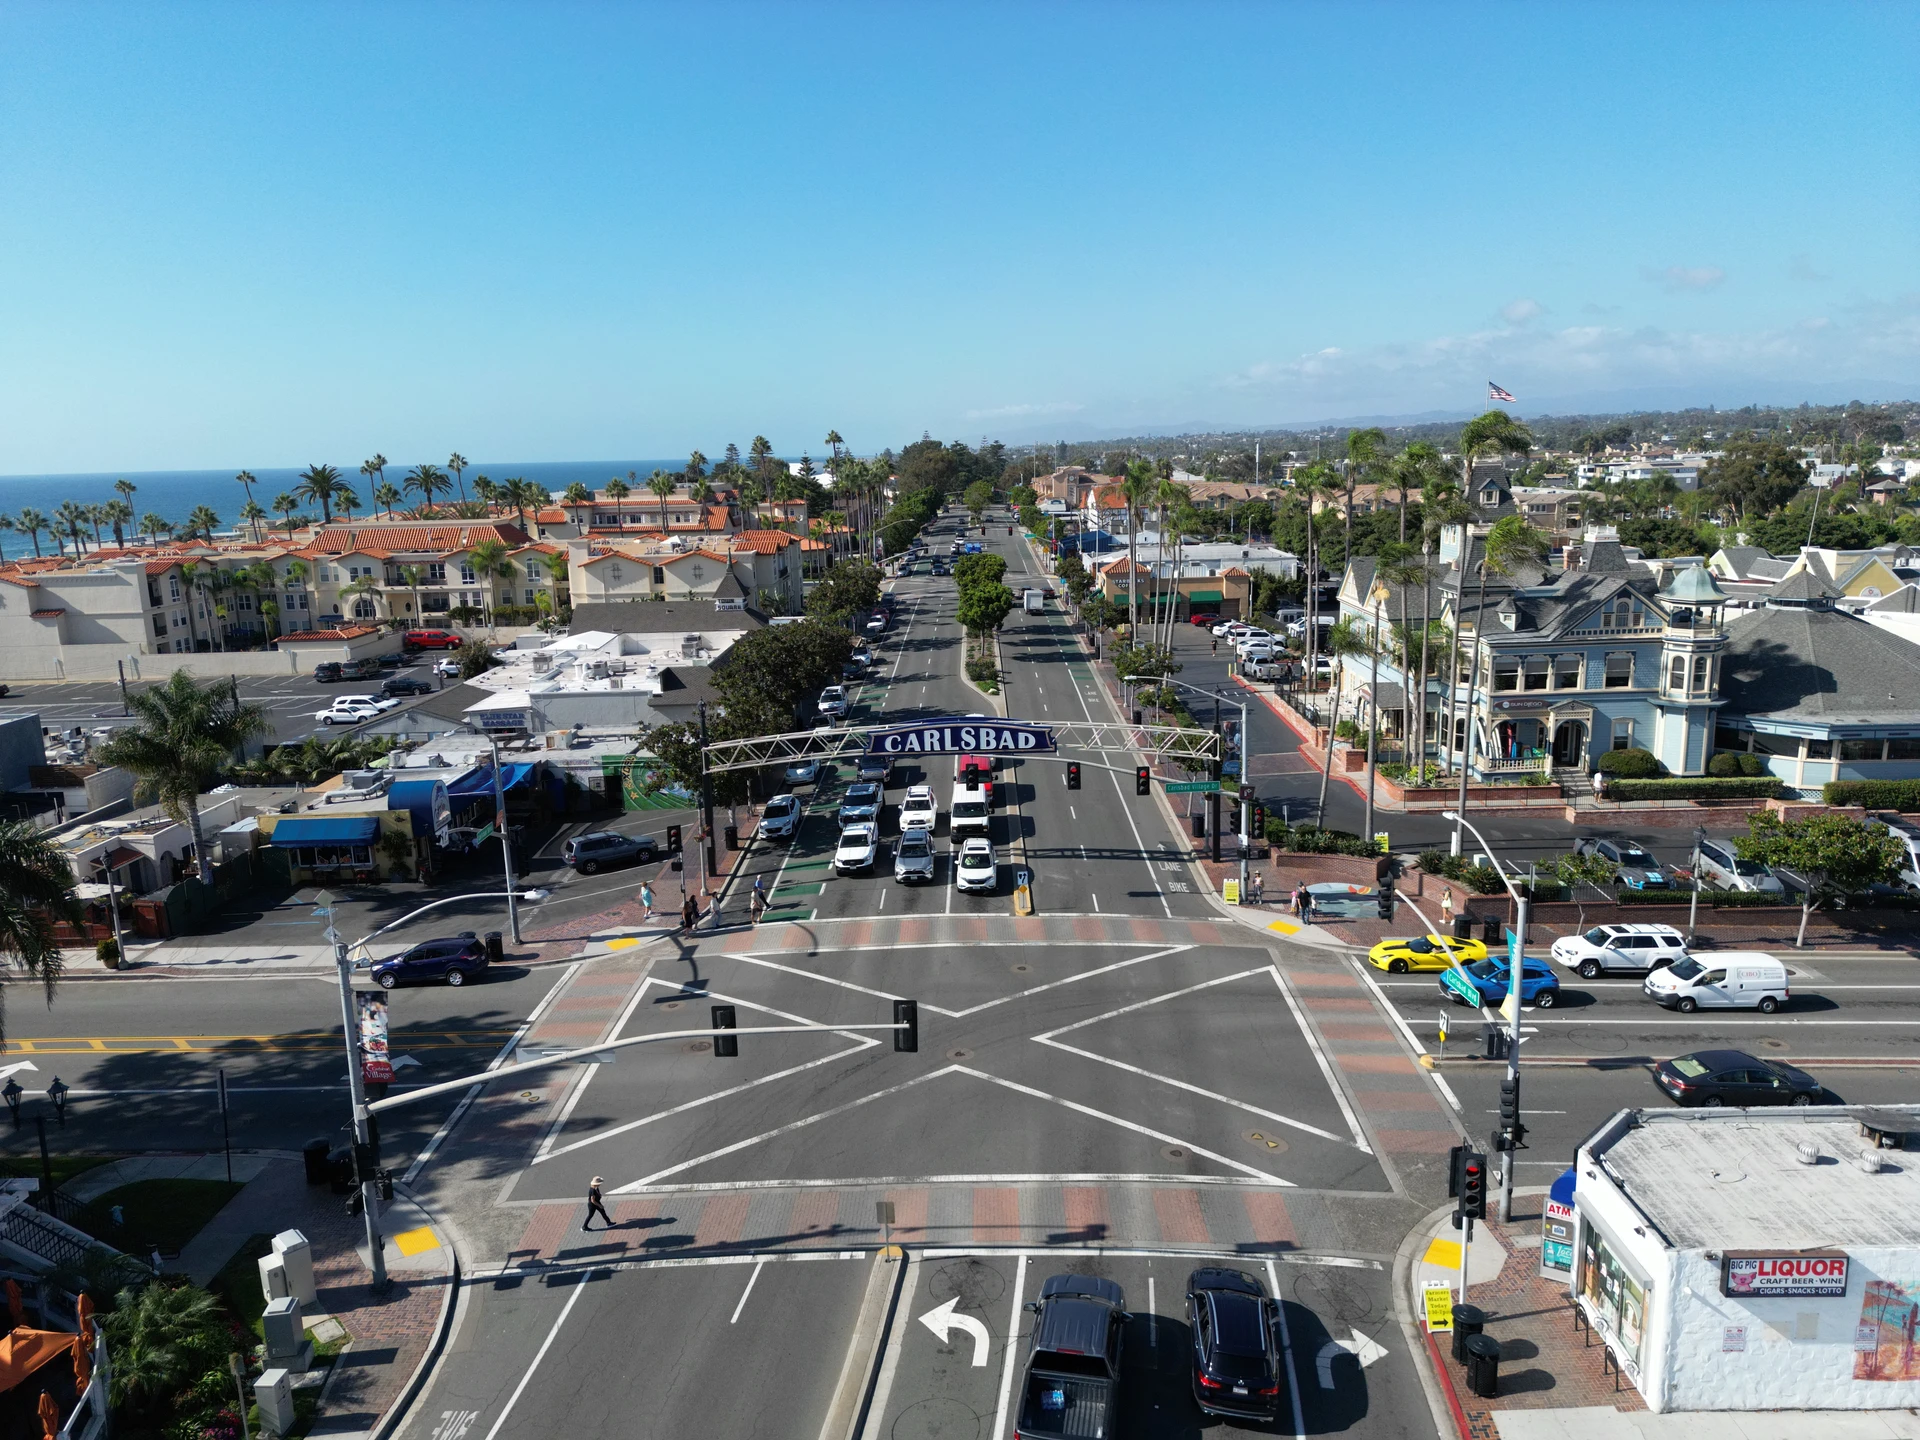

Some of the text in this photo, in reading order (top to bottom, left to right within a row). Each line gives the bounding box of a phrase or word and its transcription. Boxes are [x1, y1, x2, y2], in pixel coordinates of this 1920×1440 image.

[480, 711, 526, 720] BLUE STAR
[884, 727, 1036, 752] CARLSBAD
[1158, 862, 1182, 871] LANE
[1168, 882, 1189, 892] BIKE
[1448, 973, 1477, 1003] Carlsbad Blvd
[365, 1071, 392, 1079] Village
[1548, 1204, 1571, 1217] ATM
[1731, 1261, 1757, 1269] BIG PIG
[1758, 1260, 1845, 1277] LIQUOR
[1818, 1286, 1842, 1294] LOTTO
